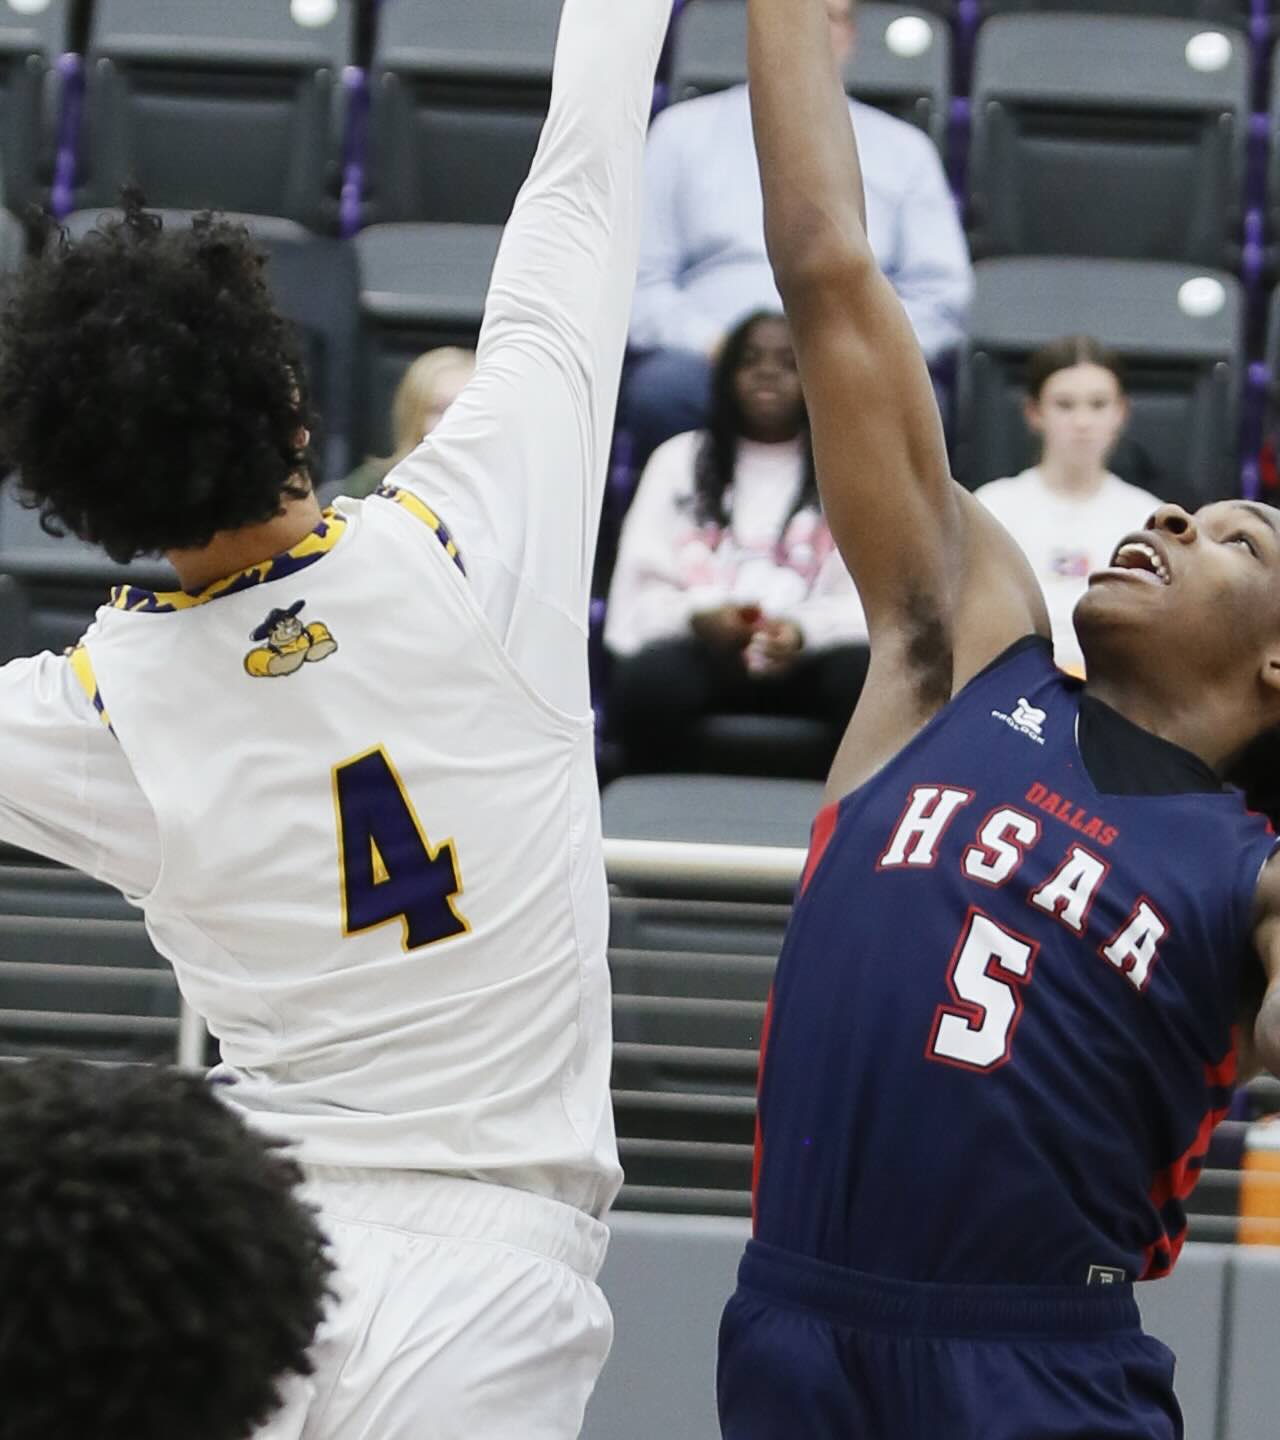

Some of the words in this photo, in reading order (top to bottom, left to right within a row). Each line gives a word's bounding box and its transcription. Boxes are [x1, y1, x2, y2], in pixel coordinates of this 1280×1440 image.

[331, 743, 472, 953] 4
[875, 783, 1169, 992] HSAA
[1025, 781, 1119, 846] DALLAS
[924, 905, 1040, 1074] 5
